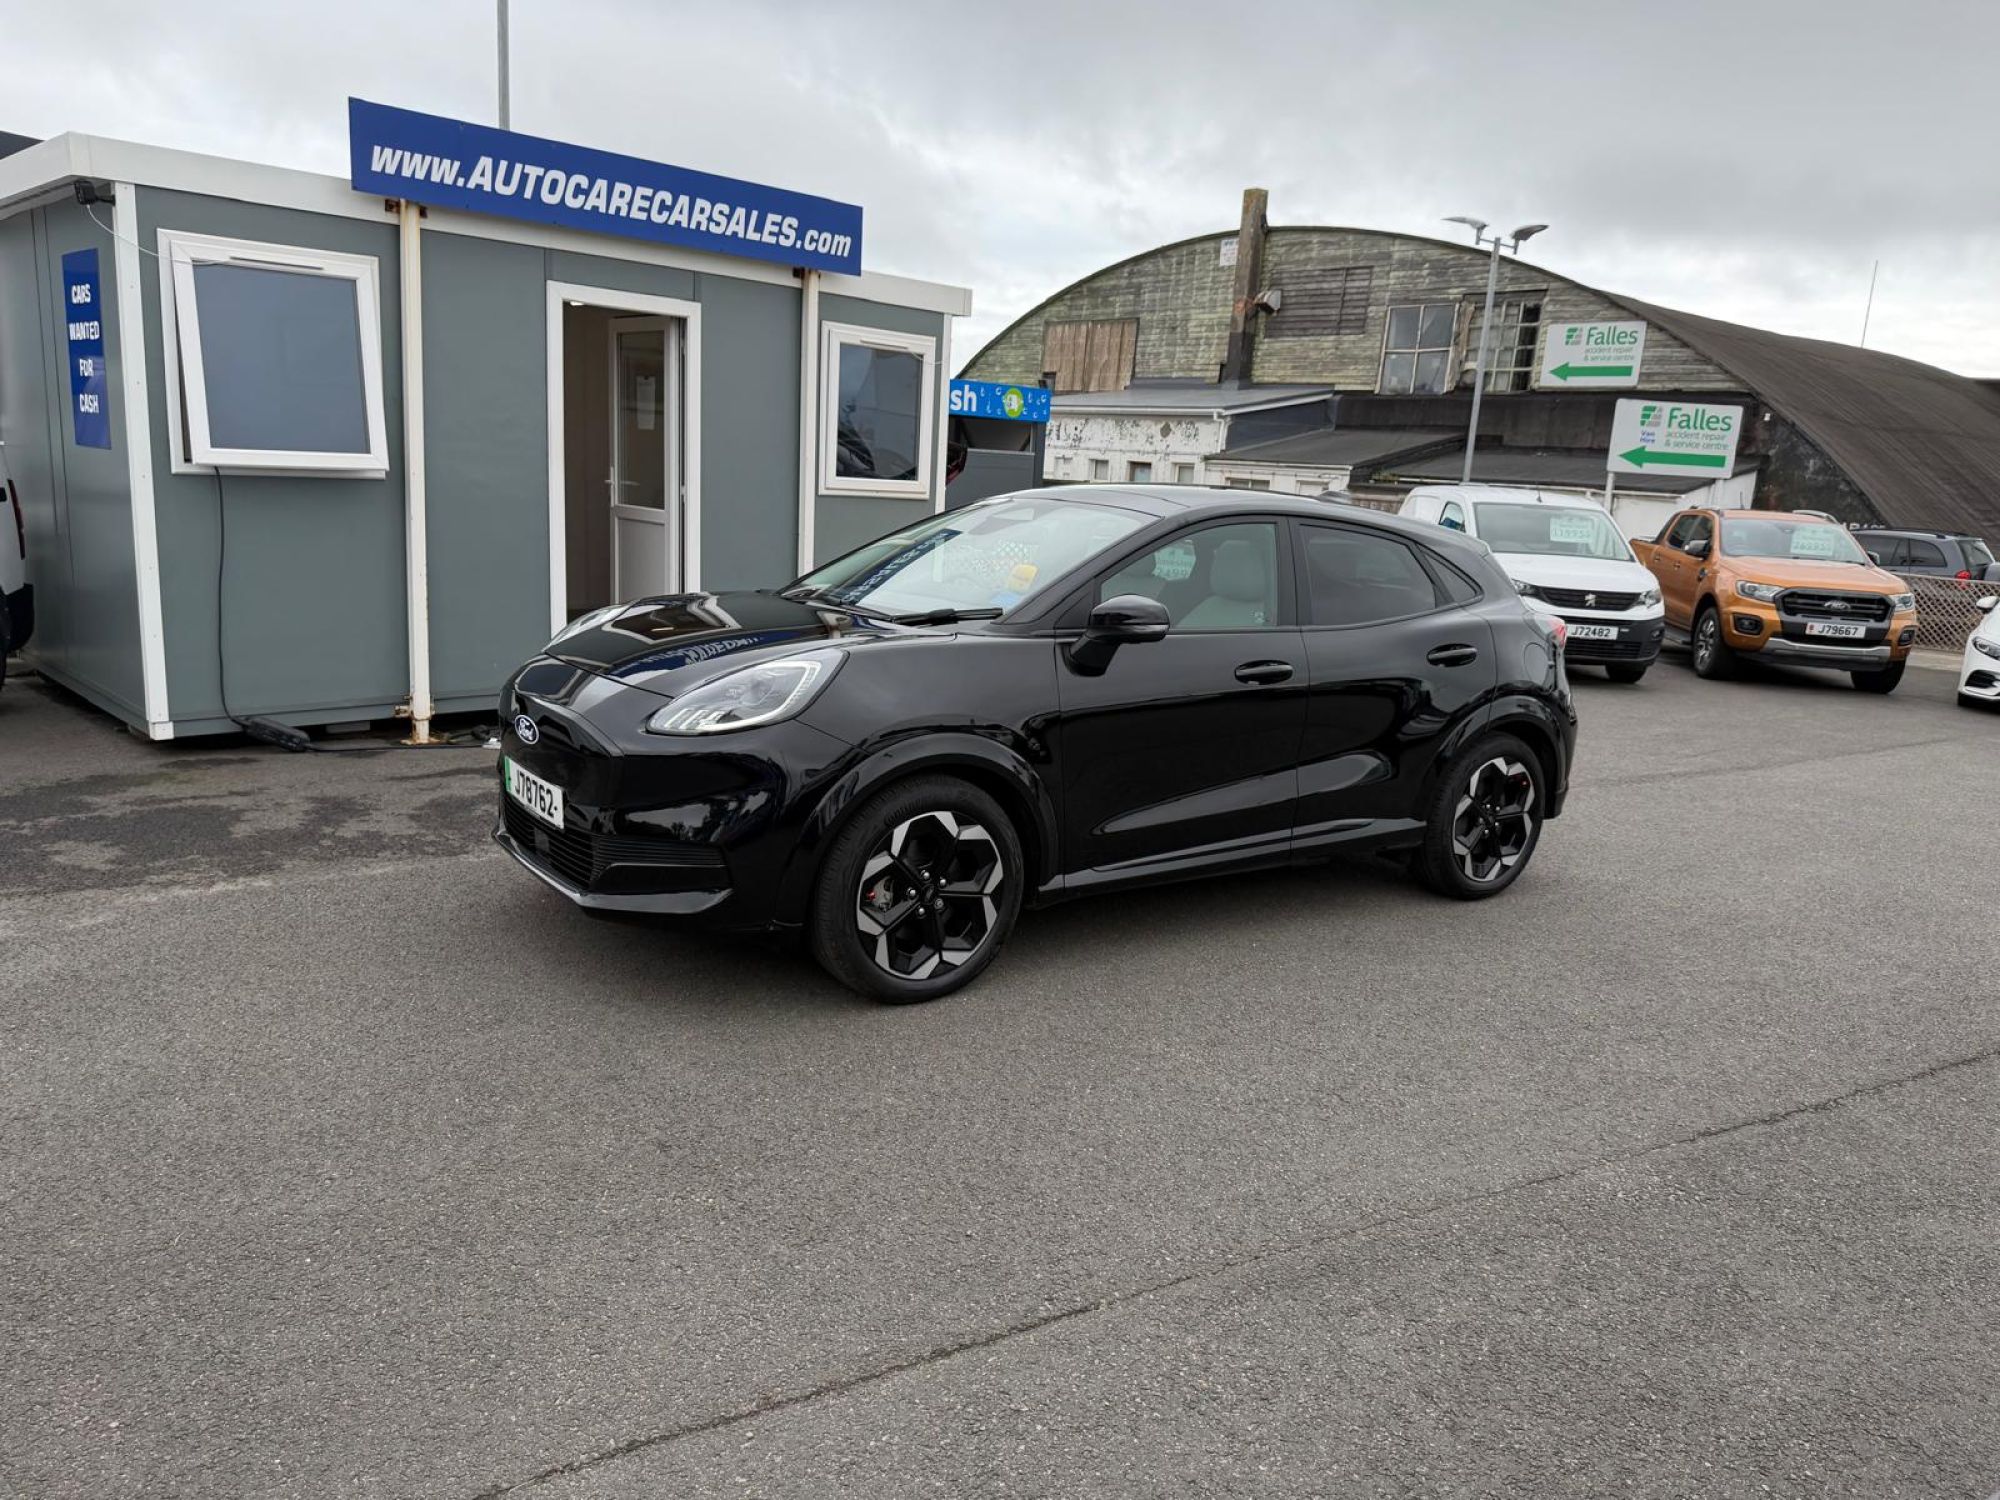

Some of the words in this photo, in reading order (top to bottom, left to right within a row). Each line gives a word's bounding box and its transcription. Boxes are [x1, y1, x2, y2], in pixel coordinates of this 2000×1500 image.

[371, 144, 852, 258] www.AUTOCARECARSALES.com
[71, 284, 91, 303] CARS
[69, 321, 100, 340] WANTED
[1586, 326, 1639, 345] Falles
[79, 359, 93, 377] FOR
[79, 394, 99, 413] CASH
[1668, 407, 1733, 431] Falles
[1571, 625, 1611, 637] J72482
[1818, 624, 1858, 636] J79667
[515, 769, 555, 818] J78762
